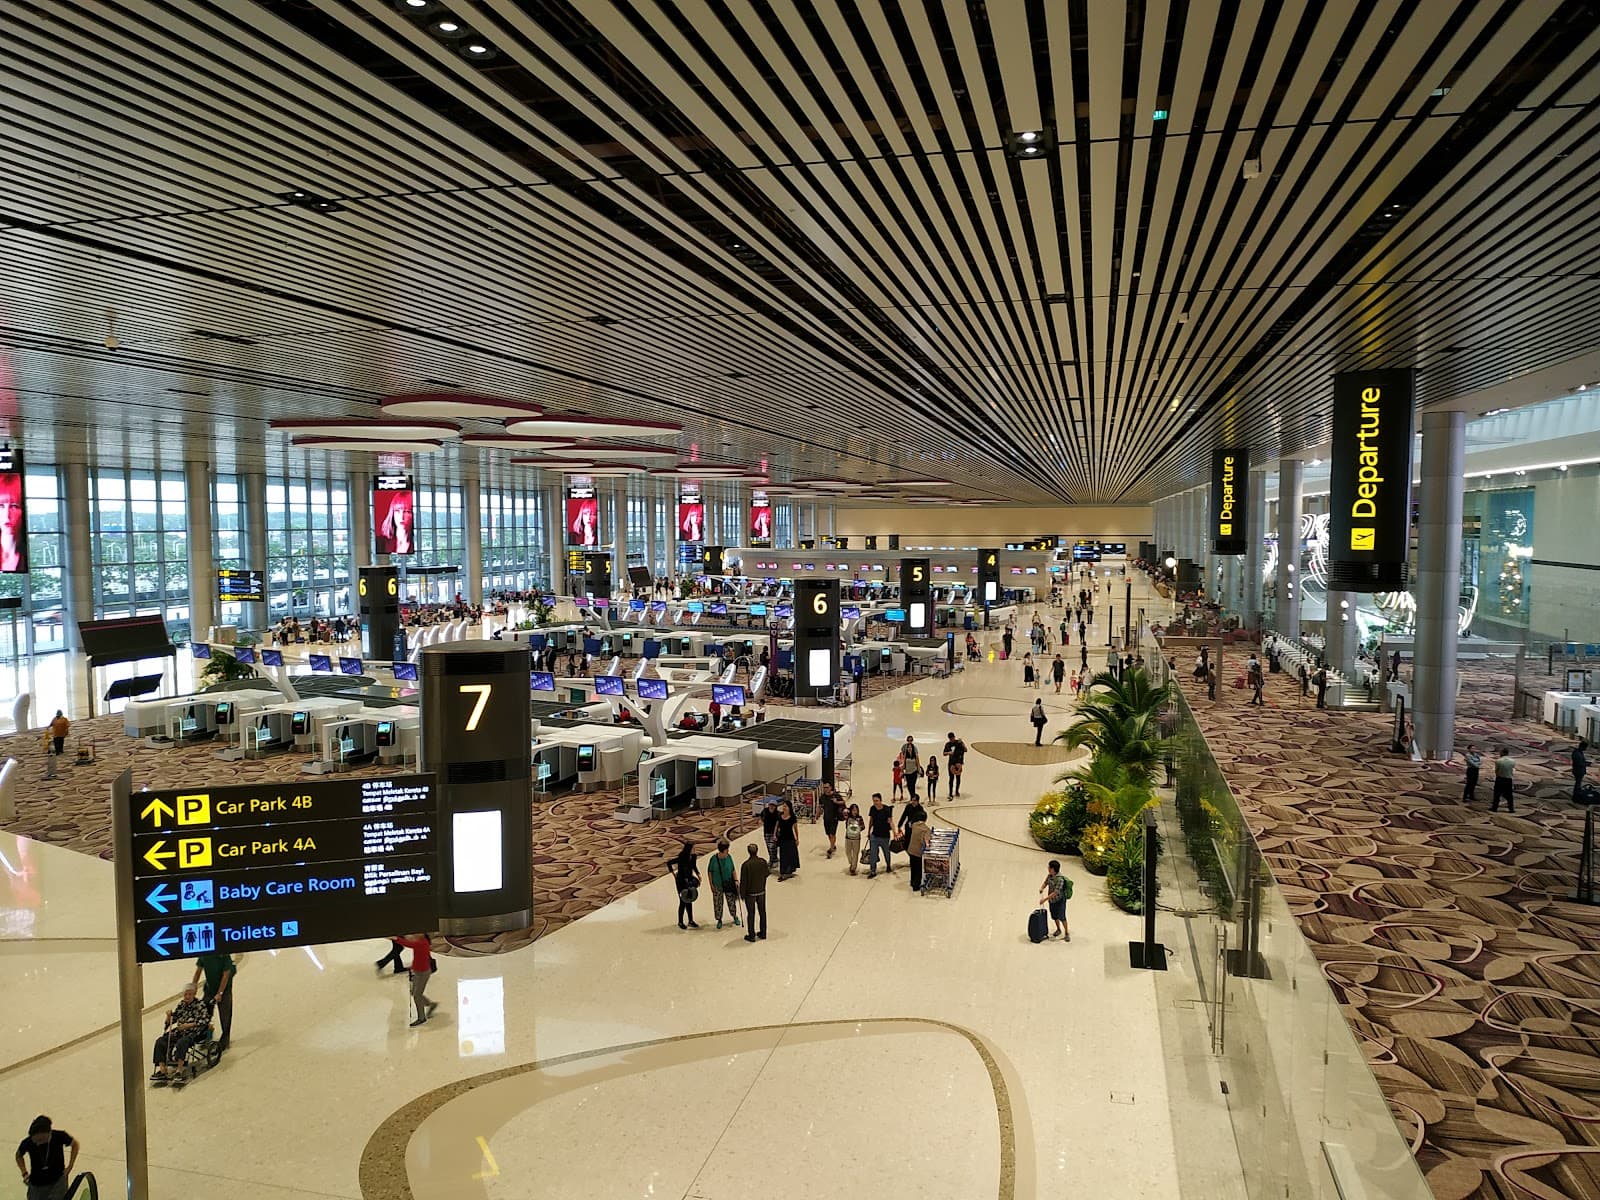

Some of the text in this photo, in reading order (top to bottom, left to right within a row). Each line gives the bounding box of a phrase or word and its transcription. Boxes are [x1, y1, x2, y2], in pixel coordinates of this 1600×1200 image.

[1352, 387, 1384, 518] Departure
[1220, 456, 1236, 520] Departure
[704, 551, 711, 562] 4
[987, 554, 996, 566] 4
[586, 560, 592, 574] 5
[605, 560, 611, 573] 5
[913, 566, 923, 582] 5
[359, 577, 397, 596] 6 6
[813, 592, 828, 615] 6
[460, 684, 491, 731] 7
[216, 801, 245, 814] Car
[250, 797, 287, 812] Park
[292, 795, 313, 809] 4B
[217, 844, 247, 857] Car
[252, 839, 288, 854] Park
[293, 837, 316, 851] 4A
[219, 884, 261, 900] Baby
[266, 881, 303, 895] Care
[309, 877, 356, 891] Room
[221, 925, 276, 941] Toilets
